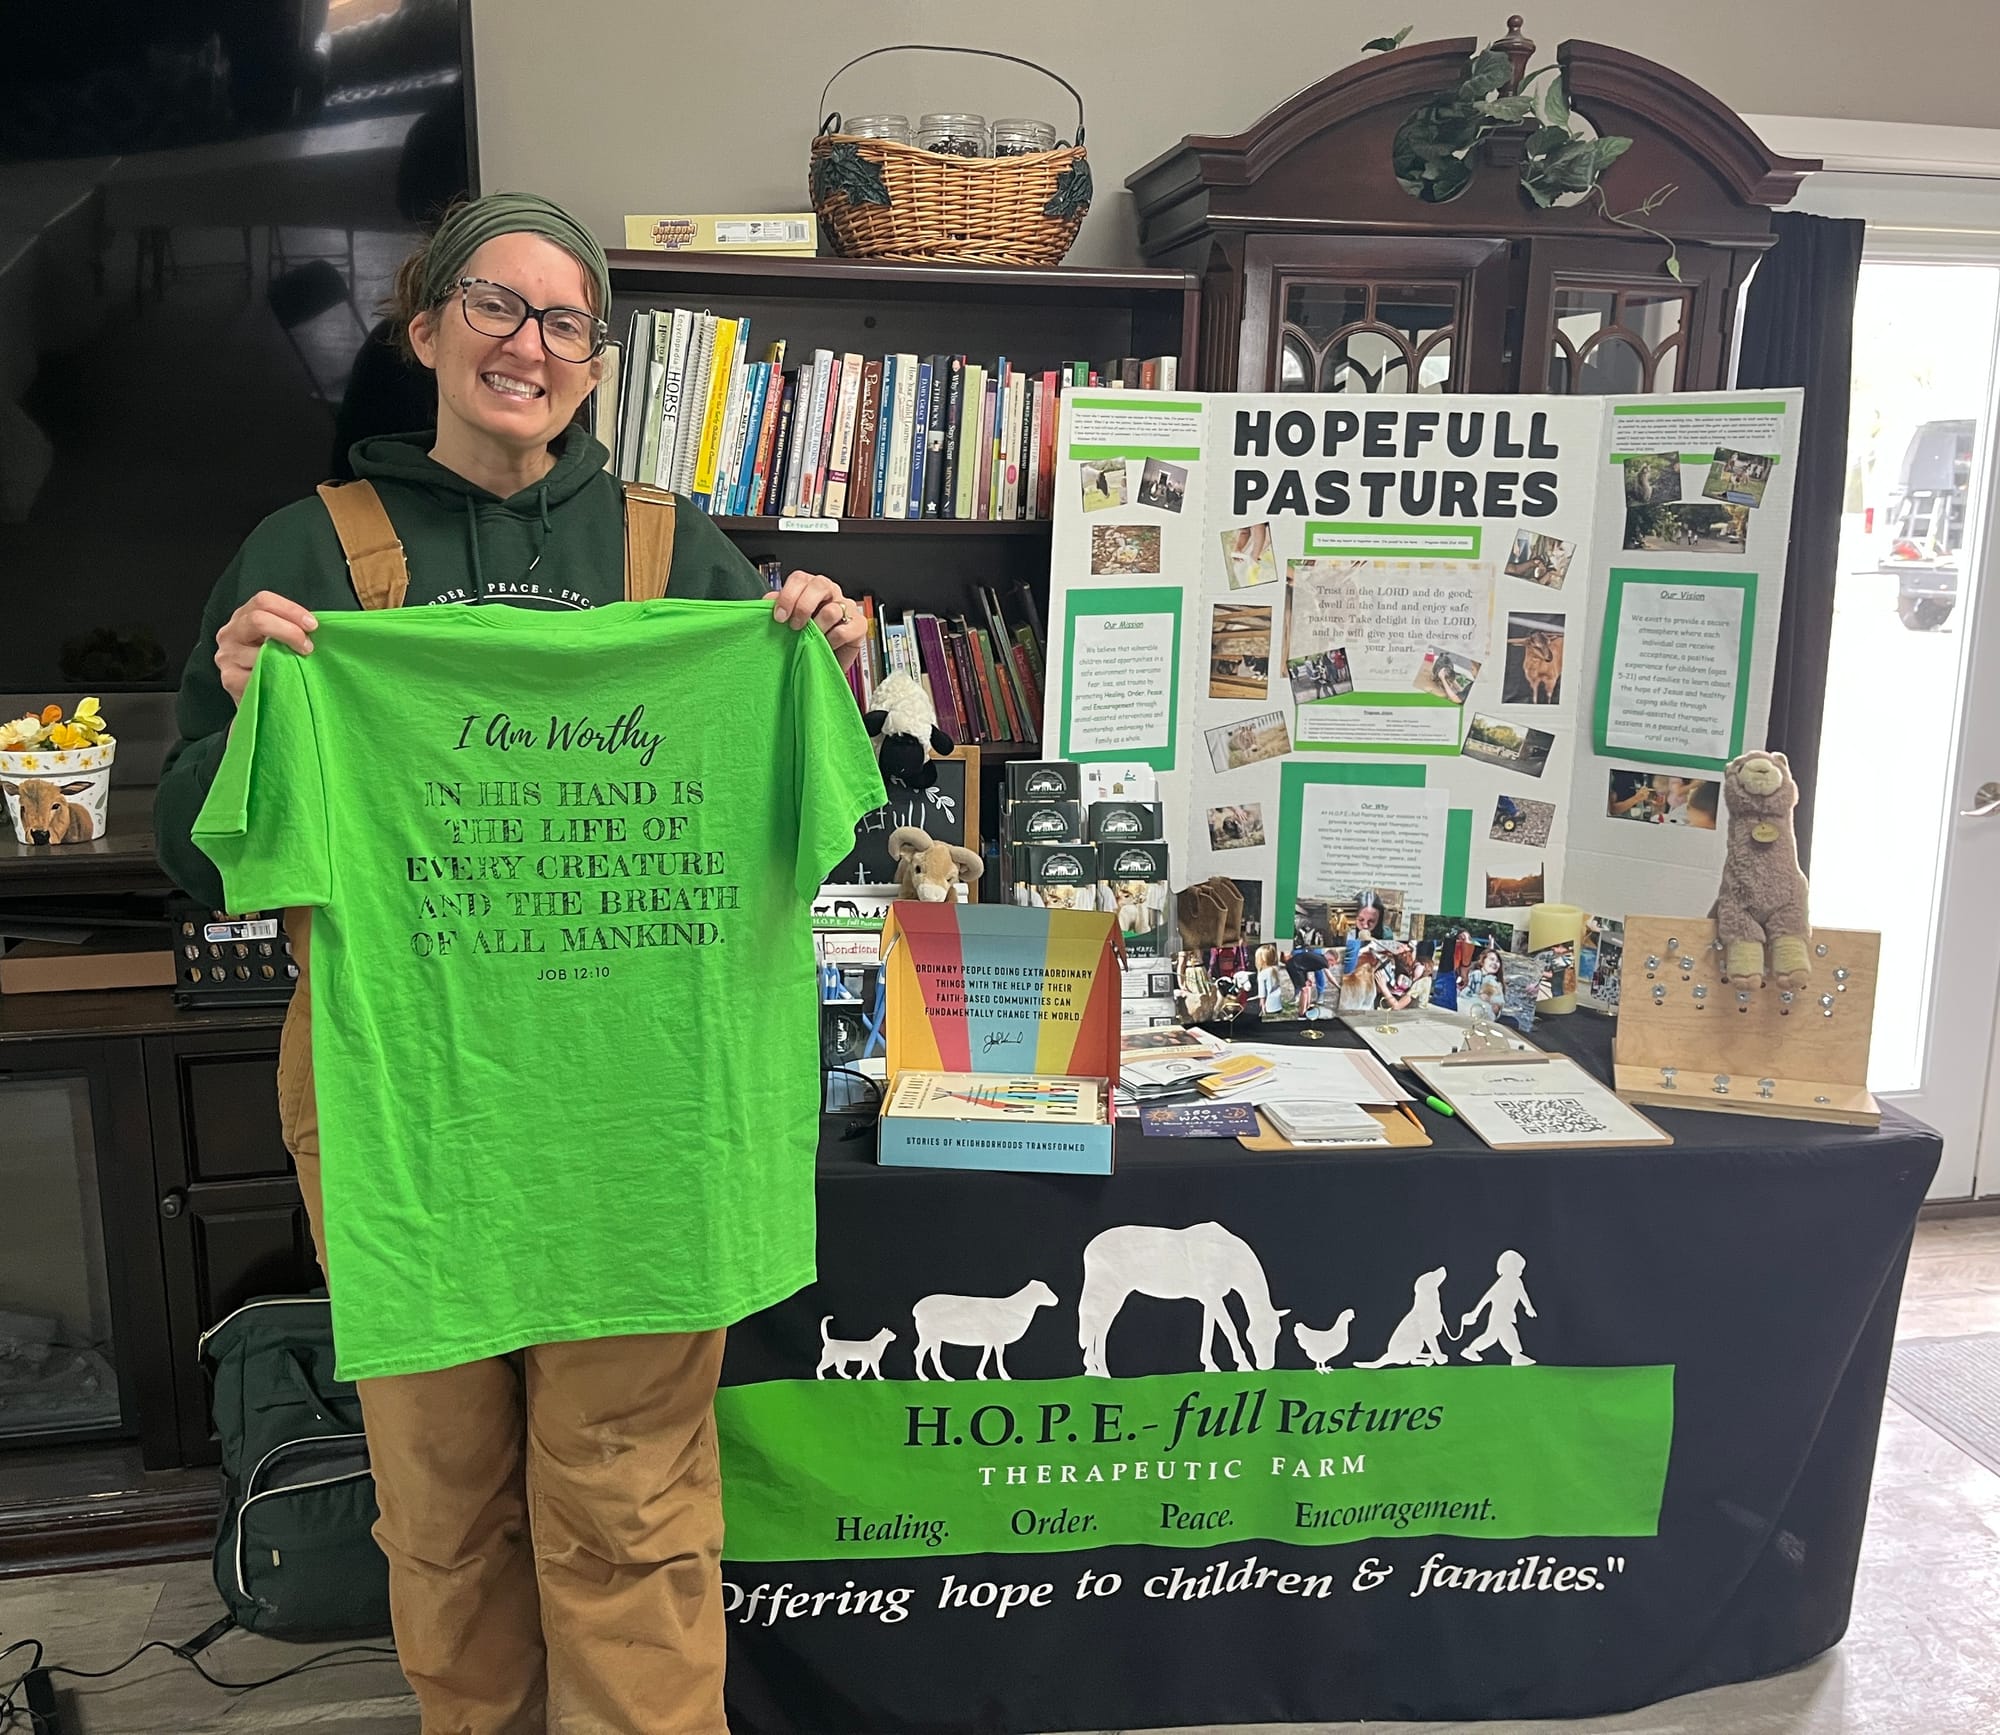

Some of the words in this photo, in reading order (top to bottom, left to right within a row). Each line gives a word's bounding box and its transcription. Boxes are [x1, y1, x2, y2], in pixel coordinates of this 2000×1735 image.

[673, 314, 685, 365] Encyclopedia
[950, 374, 960, 391] Why
[663, 371, 681, 423] HORSE
[797, 388, 808, 423] OUTDOOR
[906, 399, 914, 419] Child
[932, 405, 940, 427] BOOK
[947, 424, 956, 439] Stay
[1233, 410, 1559, 459] HOPEFULL
[792, 423, 804, 464] ACTIVITIES
[810, 439, 819, 466] HORSE
[1233, 469, 1558, 518] PASTURES
[488, 583, 539, 593] PEACE
[1316, 586, 1342, 595] Trust
[1346, 587, 1355, 595] in
[1359, 587, 1373, 596] the
[1378, 587, 1408, 596] LORD
[1413, 589, 1430, 598] and
[1433, 590, 1444, 598] do
[1660, 591, 1676, 600] Our
[1681, 591, 1705, 601] Vision
[1318, 600, 1342, 609] dwell
[1346, 600, 1355, 609] in
[1359, 601, 1373, 610] the
[1377, 602, 1397, 611] land
[1401, 603, 1418, 611] and
[1422, 604, 1446, 614] enjoy
[1450, 604, 1469, 612] safe
[1104, 621, 1117, 630] Our
[1348, 615, 1372, 624] Take
[1376, 616, 1407, 626] delight
[1411, 616, 1420, 624] in
[1424, 616, 1438, 625] the
[1673, 617, 1699, 626] provide
[1312, 629, 1329, 637] and
[1333, 629, 1344, 637] he
[1347, 629, 1364, 638] will
[1368, 630, 1385, 640] give
[1389, 632, 1404, 640] you
[1408, 630, 1423, 639] the
[1426, 631, 1460, 640] desires
[1462, 631, 1473, 640] of
[1639, 627, 1679, 636] atmosphere
[1681, 629, 1701, 637] where
[1364, 645, 1385, 654] your
[1389, 644, 1415, 652] heart.
[1642, 639, 1673, 647] individual
[1687, 655, 1714, 663] positive
[453, 714, 481, 751] I
[485, 713, 538, 752] Am
[546, 704, 666, 766] Worthy
[424, 781, 462, 807] IN
[479, 781, 542, 807] HIS
[557, 781, 658, 807] HAND
[671, 781, 705, 806] IS
[444, 819, 524, 844] THE
[539, 818, 626, 842] LIFE
[642, 816, 688, 842] OF
[406, 856, 526, 882] EVERY
[536, 851, 725, 880] CREATURE
[418, 893, 492, 919] AND
[506, 891, 582, 917] THE
[599, 886, 742, 916] BREATH
[410, 930, 458, 957] OF
[472, 929, 545, 954] ALL
[560, 922, 726, 952] MANKIND.
[826, 942, 877, 954] Donations
[537, 968, 567, 981] JOB
[574, 966, 611, 979] 12:10
[916, 964, 957, 974] ORDINARY
[961, 966, 991, 975] PEOPLE
[994, 967, 1020, 976] DOING
[1023, 968, 1092, 979] EXTRAORDINARY
[936, 979, 965, 989] THINGS
[969, 981, 989, 990] WITH
[993, 981, 1008, 990] THE
[1011, 982, 1031, 991] HELP
[1034, 983, 1044, 991] OF
[1048, 983, 1072, 992] THEIR
[937, 993, 990, 1004] FAITH-BASED
[993, 995, 1051, 1006] COMMUNITIES
[1054, 998, 1071, 1006] CAN
[925, 1007, 994, 1018] FUNDAMENTALLY
[997, 1010, 1030, 1019] CHANGE
[1033, 1011, 1049, 1020] THE
[907, 1137, 940, 1146] STORIES
[943, 1138, 952, 1146] OF
[957, 1139, 1023, 1149] NEIGHBORHOODS
[1026, 1142, 1085, 1151] TRANSFORMED
[1164, 1388, 1267, 1451] full
[1275, 1399, 1444, 1436] Pastures
[978, 1459, 1242, 1486] THERAPEUTIC
[1271, 1454, 1367, 1479] FARM
[834, 1514, 949, 1548] Healing.
[1011, 1507, 1098, 1536] Order.
[1160, 1502, 1234, 1530] Peace.
[1295, 1496, 1496, 1529] Encouragement.
[938, 1574, 1054, 1619] hope
[1076, 1568, 1122, 1601] to
[1143, 1556, 1332, 1601] children
[1351, 1556, 1394, 1593] &
[1409, 1552, 1626, 1598] families."
